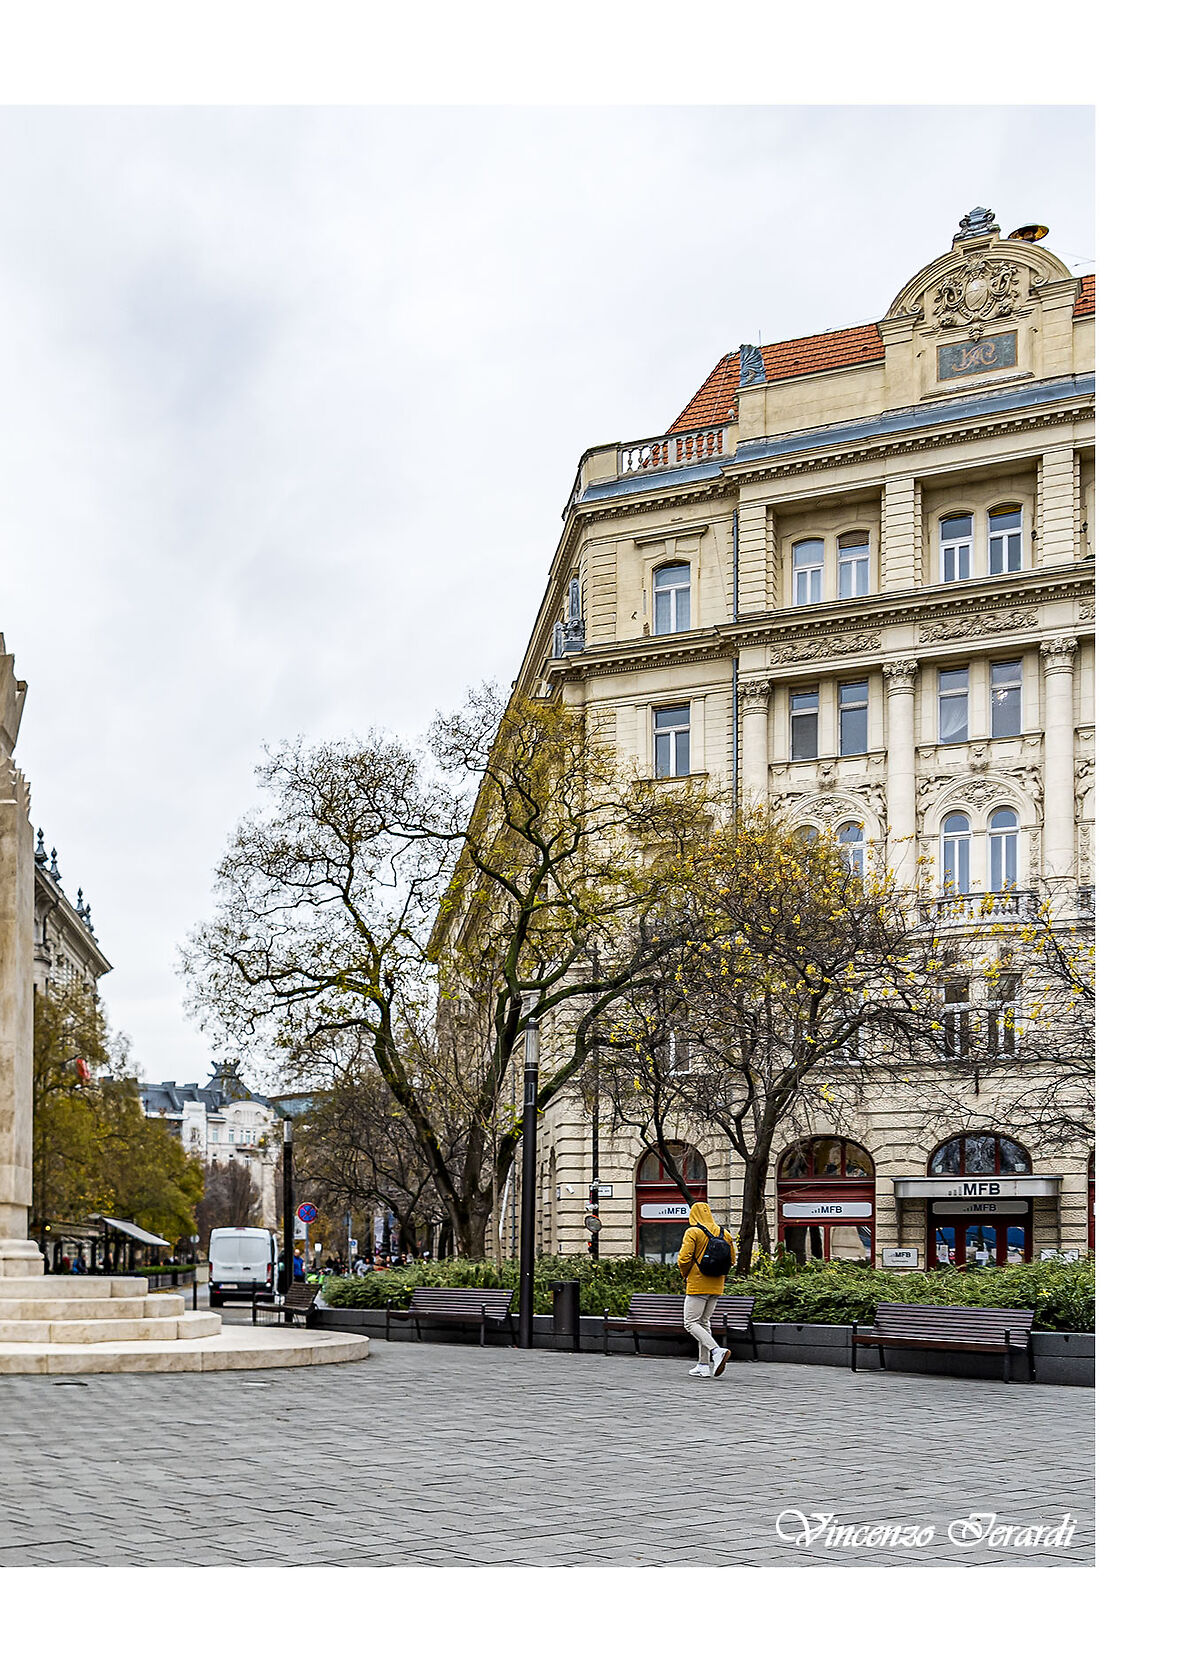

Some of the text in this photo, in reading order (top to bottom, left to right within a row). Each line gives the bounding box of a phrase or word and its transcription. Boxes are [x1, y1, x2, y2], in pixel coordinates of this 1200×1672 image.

[963, 1183, 1000, 1196] MFB
[667, 1207, 687, 1215] MFB
[821, 1206, 843, 1214] MFB
[973, 1204, 997, 1212] MFB
